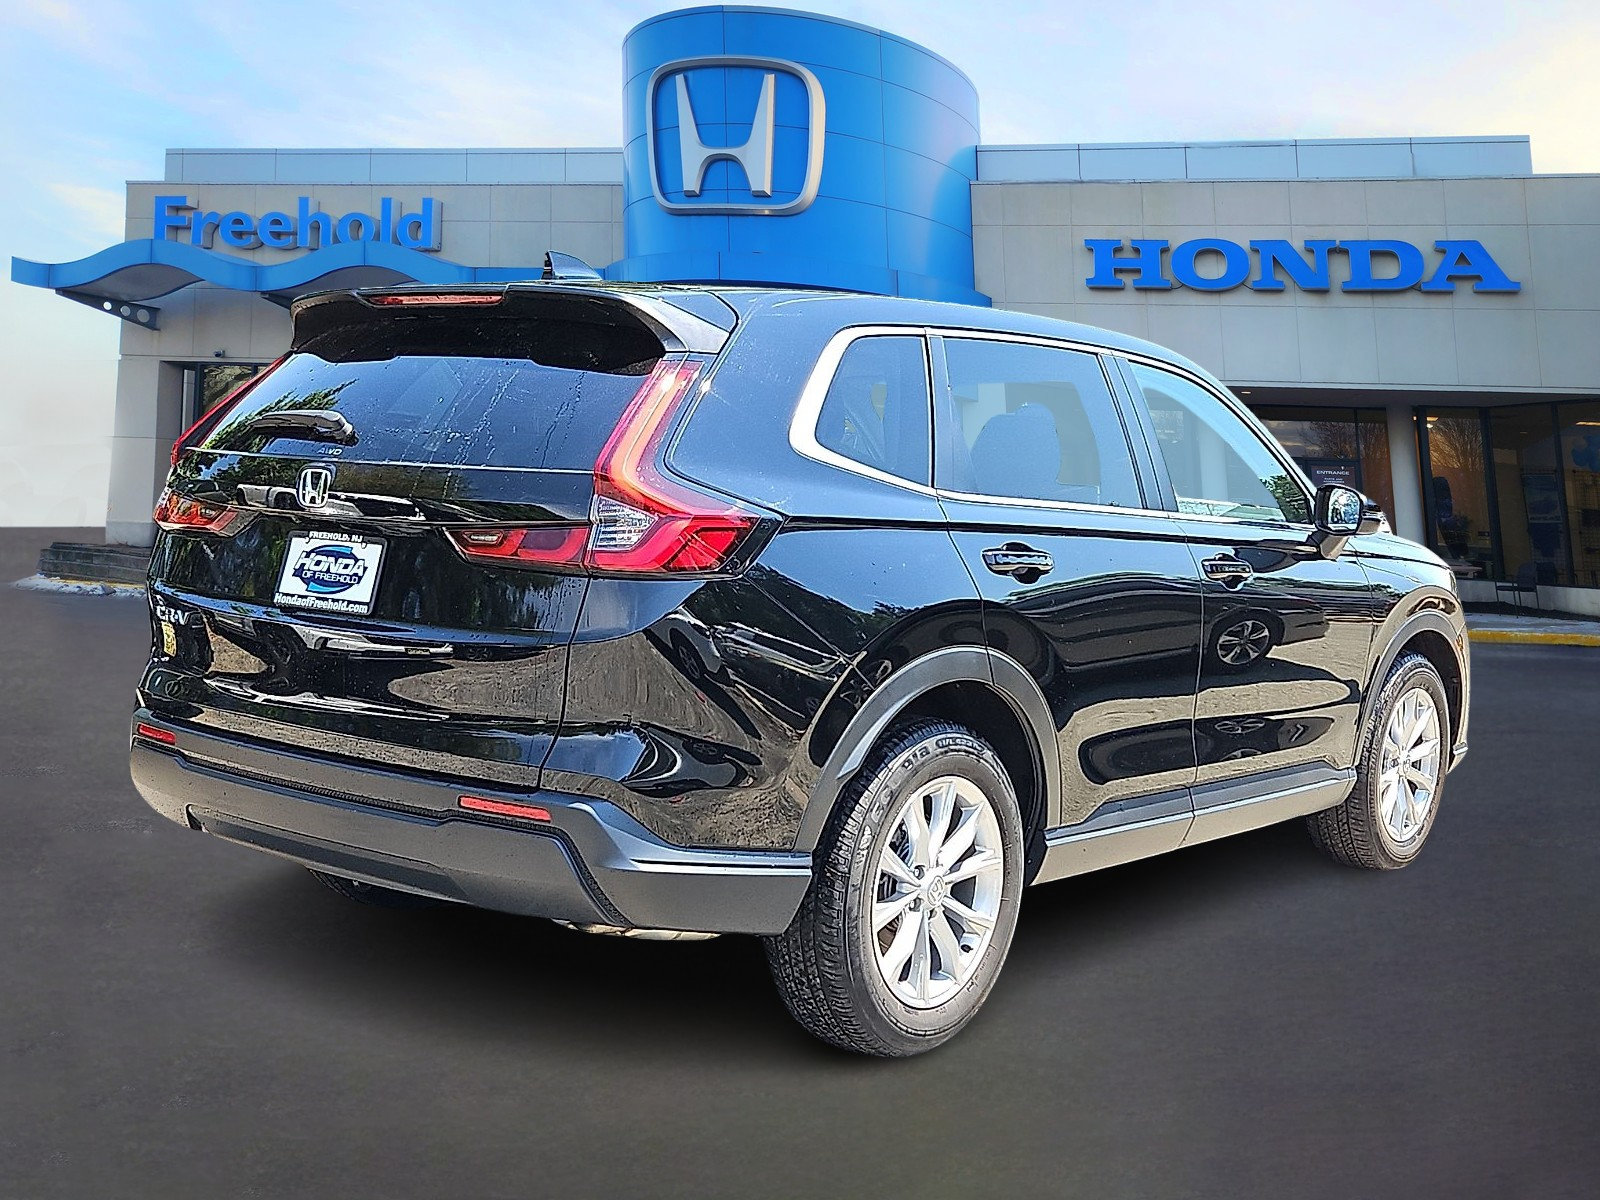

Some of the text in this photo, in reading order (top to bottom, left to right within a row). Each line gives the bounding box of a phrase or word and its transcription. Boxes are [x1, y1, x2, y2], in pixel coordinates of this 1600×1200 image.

[154, 195, 438, 250] Freehold
[1084, 238, 1521, 292] HONDA
[351, 534, 363, 543] NJ
[294, 551, 366, 577] HONDA
[302, 570, 359, 585] OF FREEHOLD
[273, 592, 369, 614] HondaofFreehold.com
